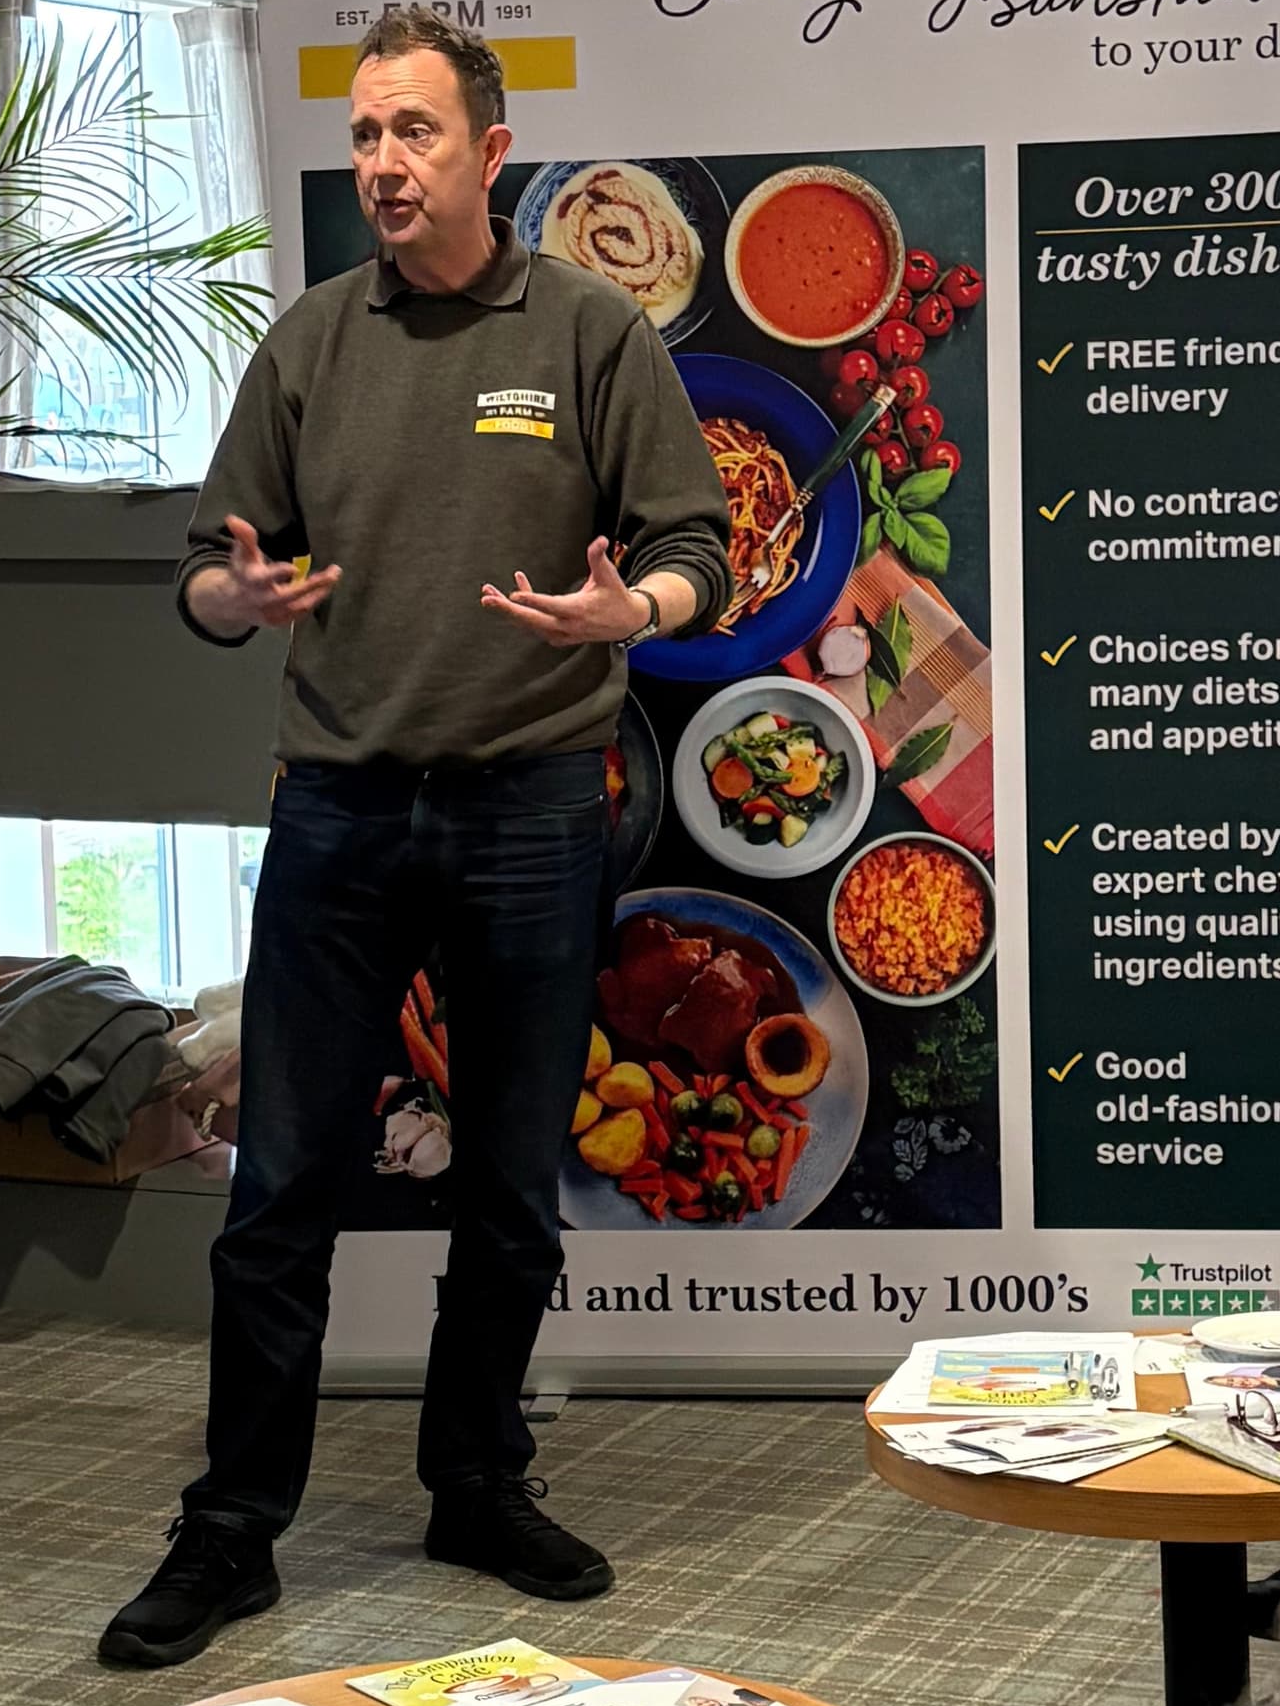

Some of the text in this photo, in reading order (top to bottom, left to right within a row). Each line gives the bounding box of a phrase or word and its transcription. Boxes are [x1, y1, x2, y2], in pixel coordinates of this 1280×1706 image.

[336, 10, 373, 26] EST.
[495, 4, 533, 20] 1991
[1090, 35, 1131, 67] to
[1144, 37, 1242, 75] your
[1075, 174, 1193, 218] Over
[1036, 244, 1160, 291] tasty
[1086, 340, 1175, 370] FREE
[1086, 385, 1227, 418] delivery
[1088, 490, 1134, 518] No
[1089, 634, 1229, 664] Choices
[1089, 676, 1280, 711] many diets
[1089, 721, 1152, 750] and
[1091, 822, 1280, 858] Created by
[1092, 867, 1205, 900] expert
[1093, 911, 1185, 943] using
[1095, 1052, 1187, 1081] Good
[1096, 1137, 1223, 1165] service
[1169, 1261, 1272, 1286] Trustpilot
[586, 1273, 675, 1313] and
[684, 1272, 857, 1313] trusted
[872, 1272, 928, 1322] by
[942, 1272, 1089, 1314] 1000's
[385, 1653, 516, 1692] The Companion
[430, 1664, 492, 1686] Café
